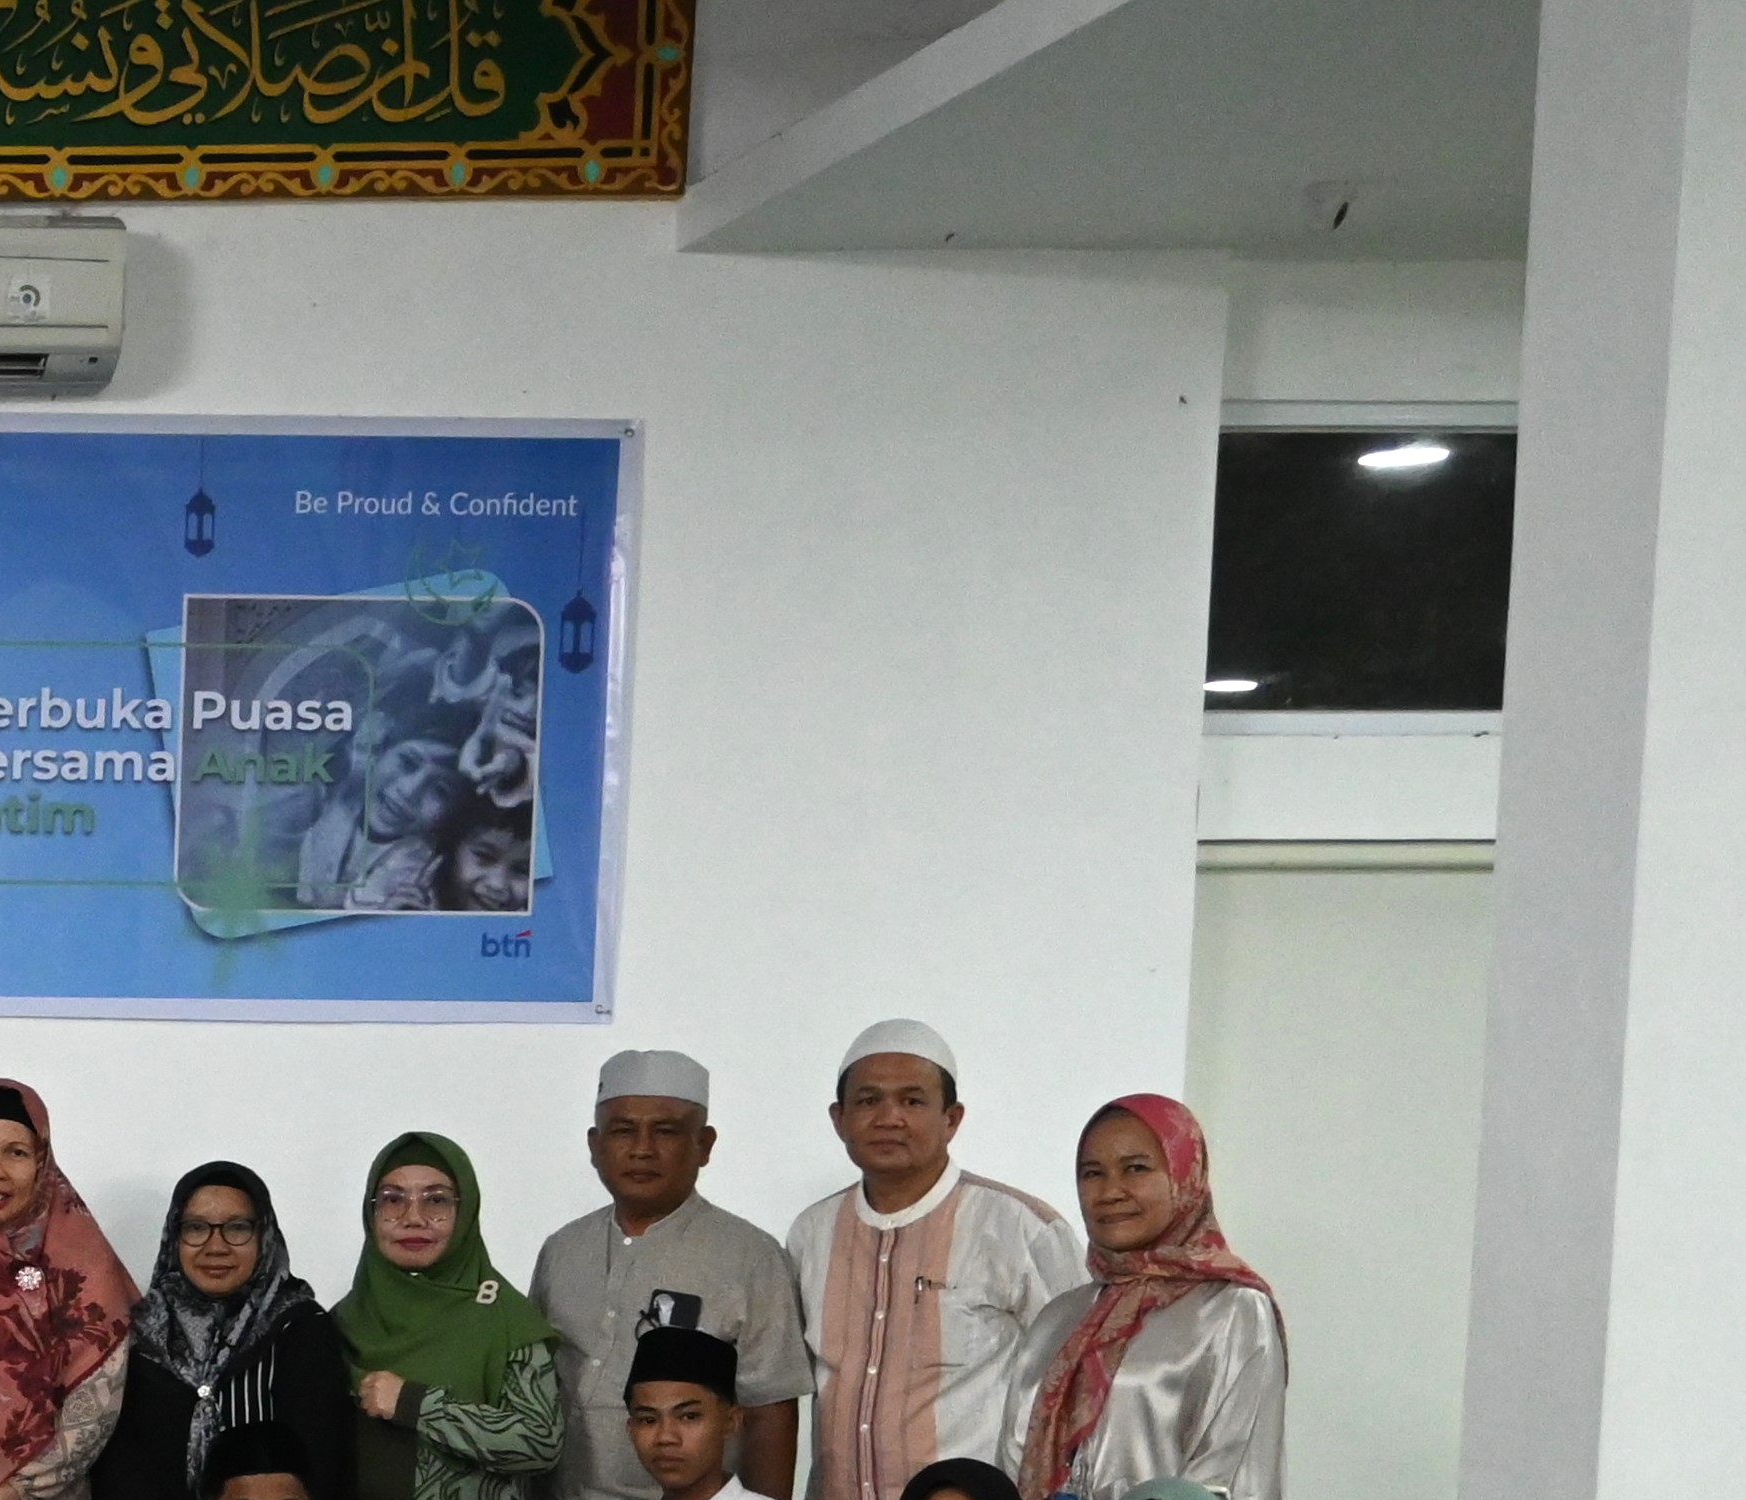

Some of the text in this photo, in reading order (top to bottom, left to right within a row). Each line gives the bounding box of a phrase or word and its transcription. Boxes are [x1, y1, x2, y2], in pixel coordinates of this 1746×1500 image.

[295, 489, 578, 518] Be Proud & Confident
[192, 689, 354, 734] Puasa
[194, 748, 335, 786] Anak
[481, 930, 534, 958] btn
